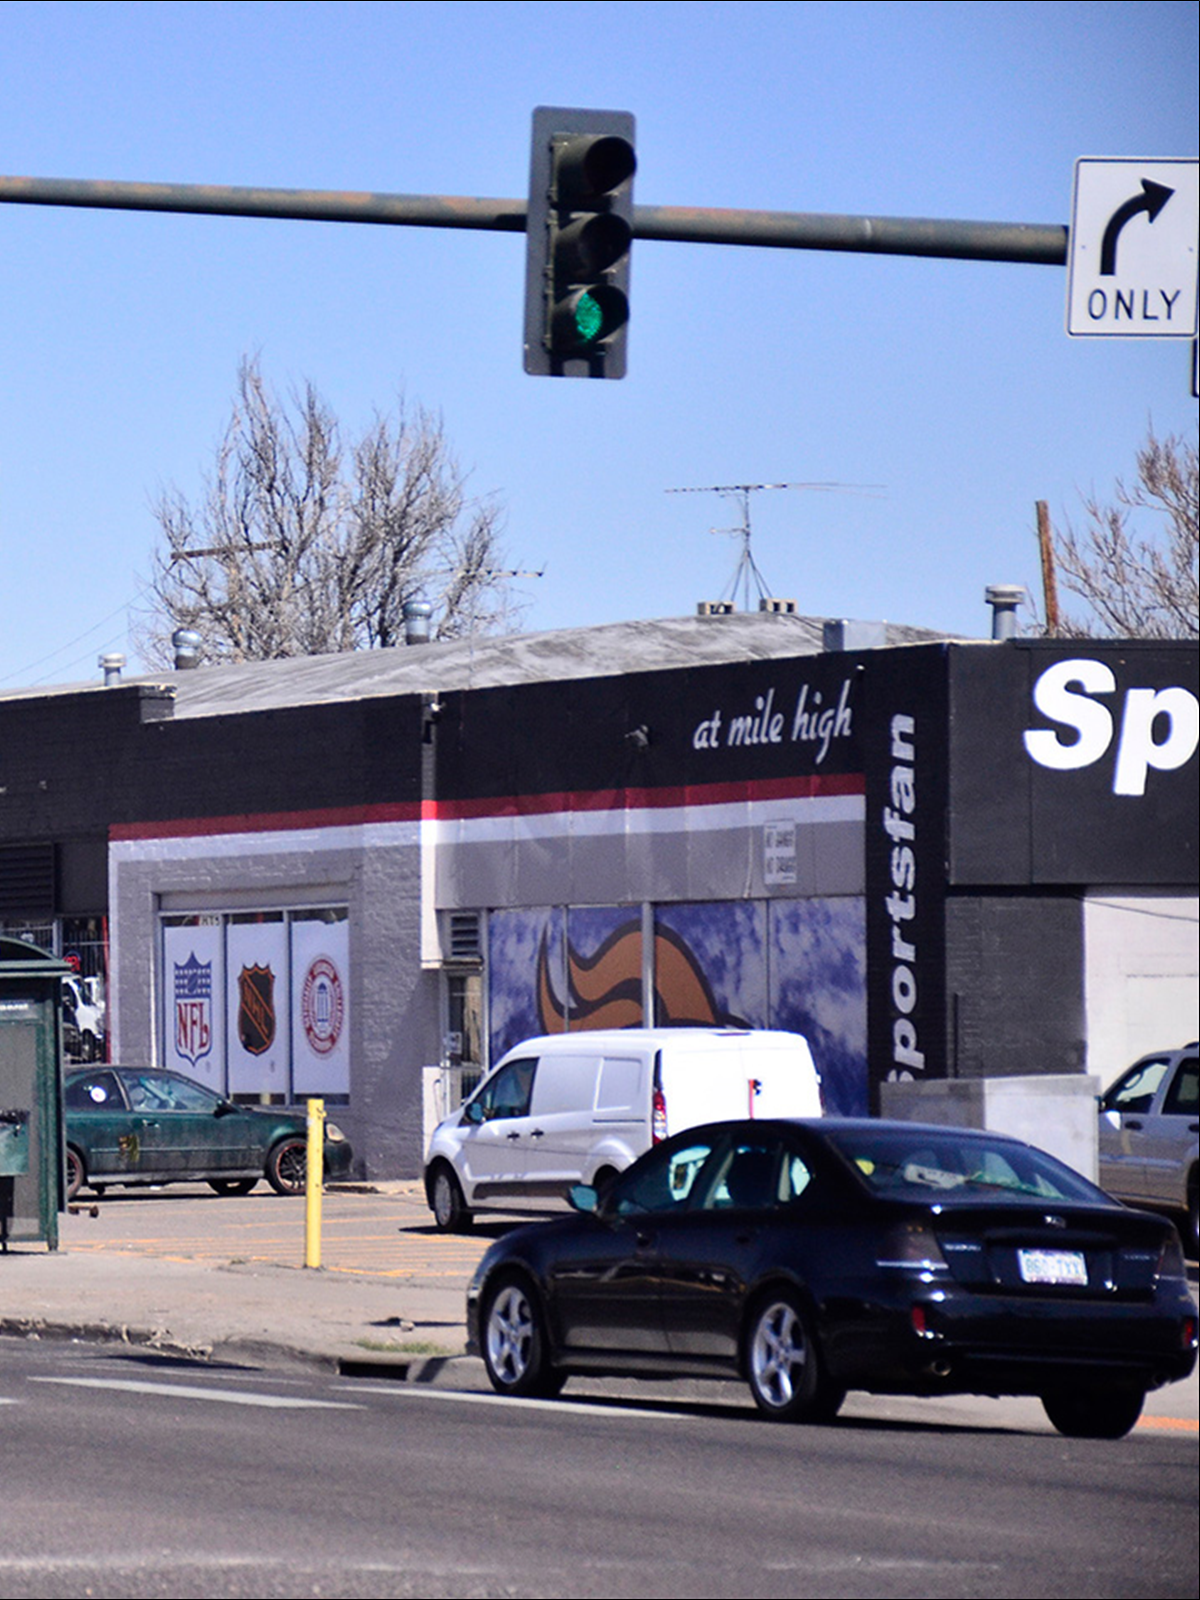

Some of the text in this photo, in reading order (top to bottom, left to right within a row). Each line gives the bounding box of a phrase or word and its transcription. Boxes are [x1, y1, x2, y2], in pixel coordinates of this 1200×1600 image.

[1087, 288, 1181, 321] ONLY
[693, 679, 852, 765] at mile high
[1024, 658, 1199, 796] Sp
[177, 1002, 209, 1057] NFL
